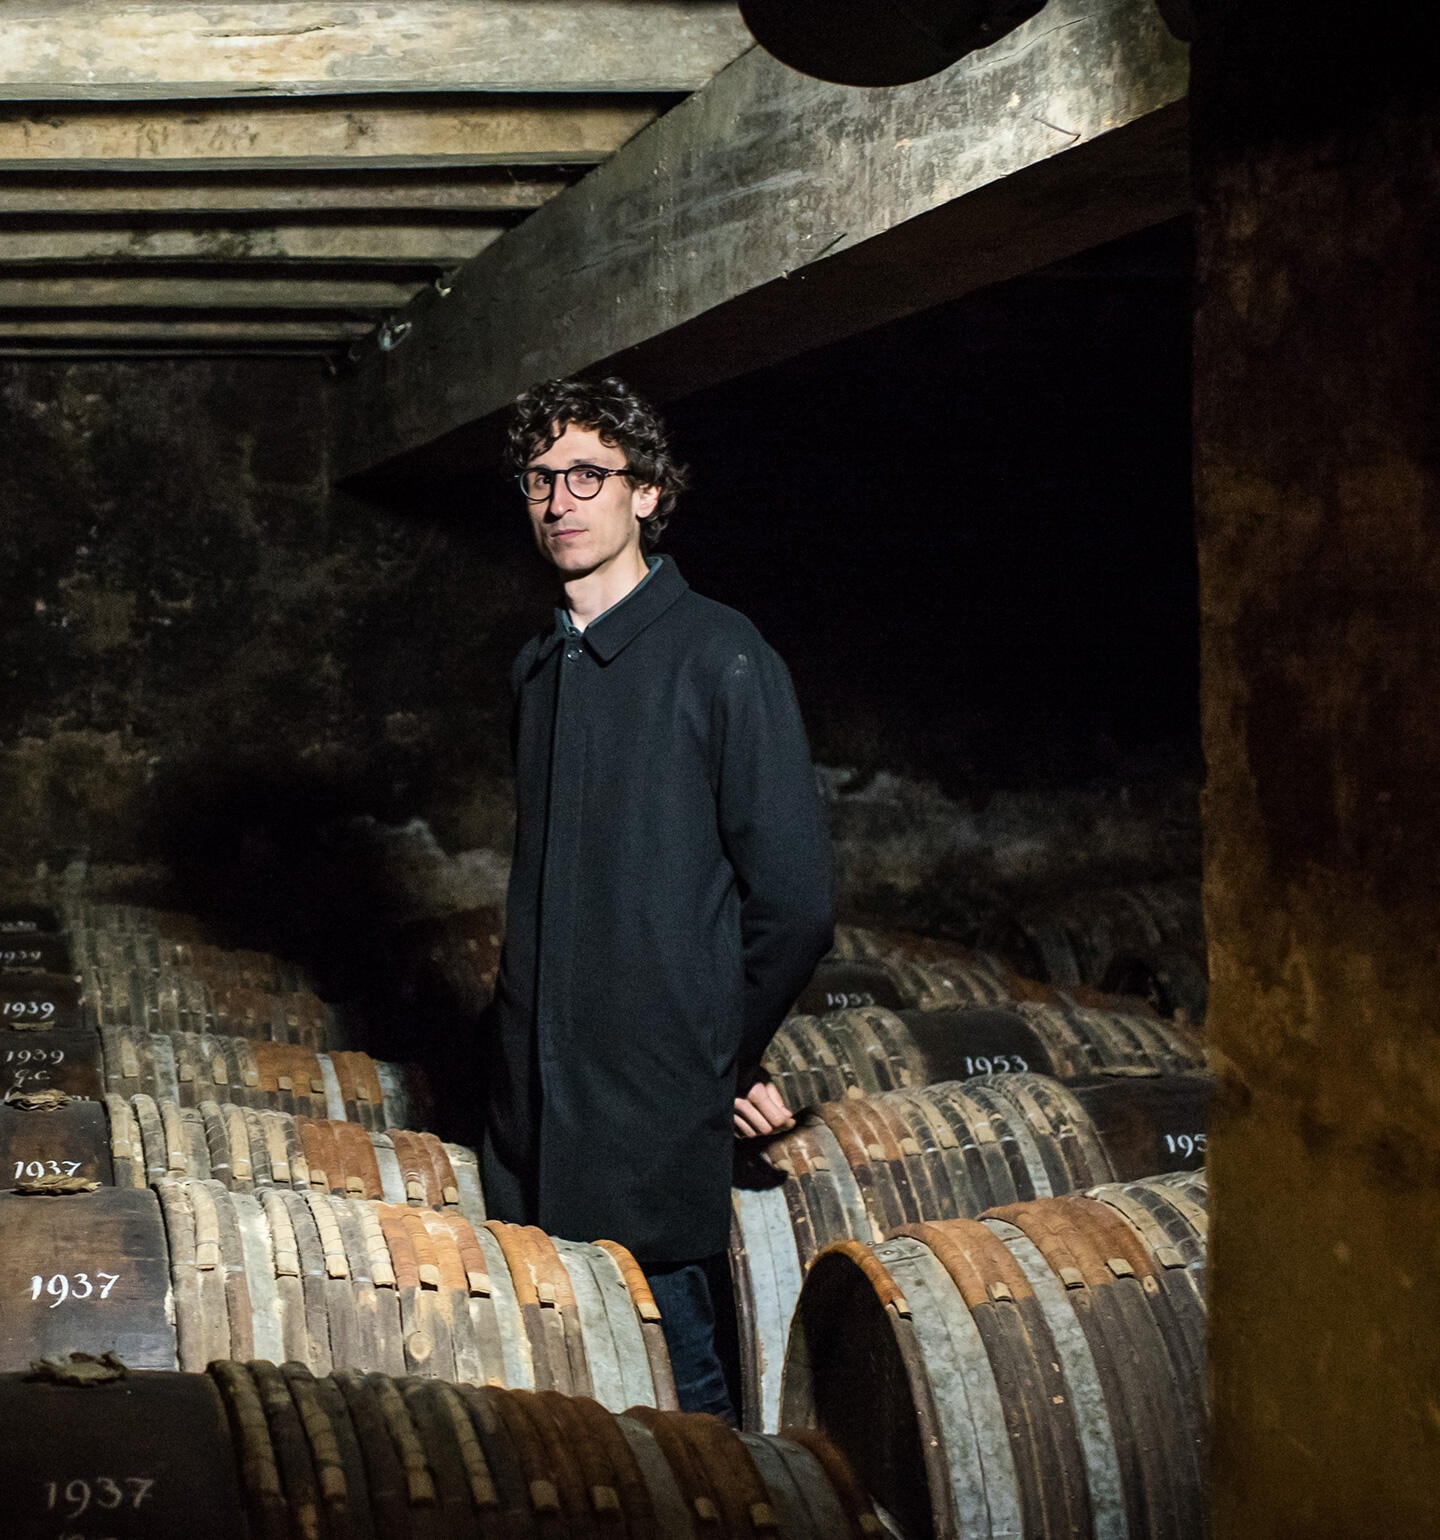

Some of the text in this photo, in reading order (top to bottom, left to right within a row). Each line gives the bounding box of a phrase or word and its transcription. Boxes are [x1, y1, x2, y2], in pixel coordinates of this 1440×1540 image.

[2, 1002, 55, 1018] 1939
[5, 1049, 65, 1065] 1939
[965, 1055, 1028, 1076] 1953
[14, 1160, 82, 1180] 1937
[30, 1272, 120, 1308] 1937
[44, 1476, 154, 1519] 1937
